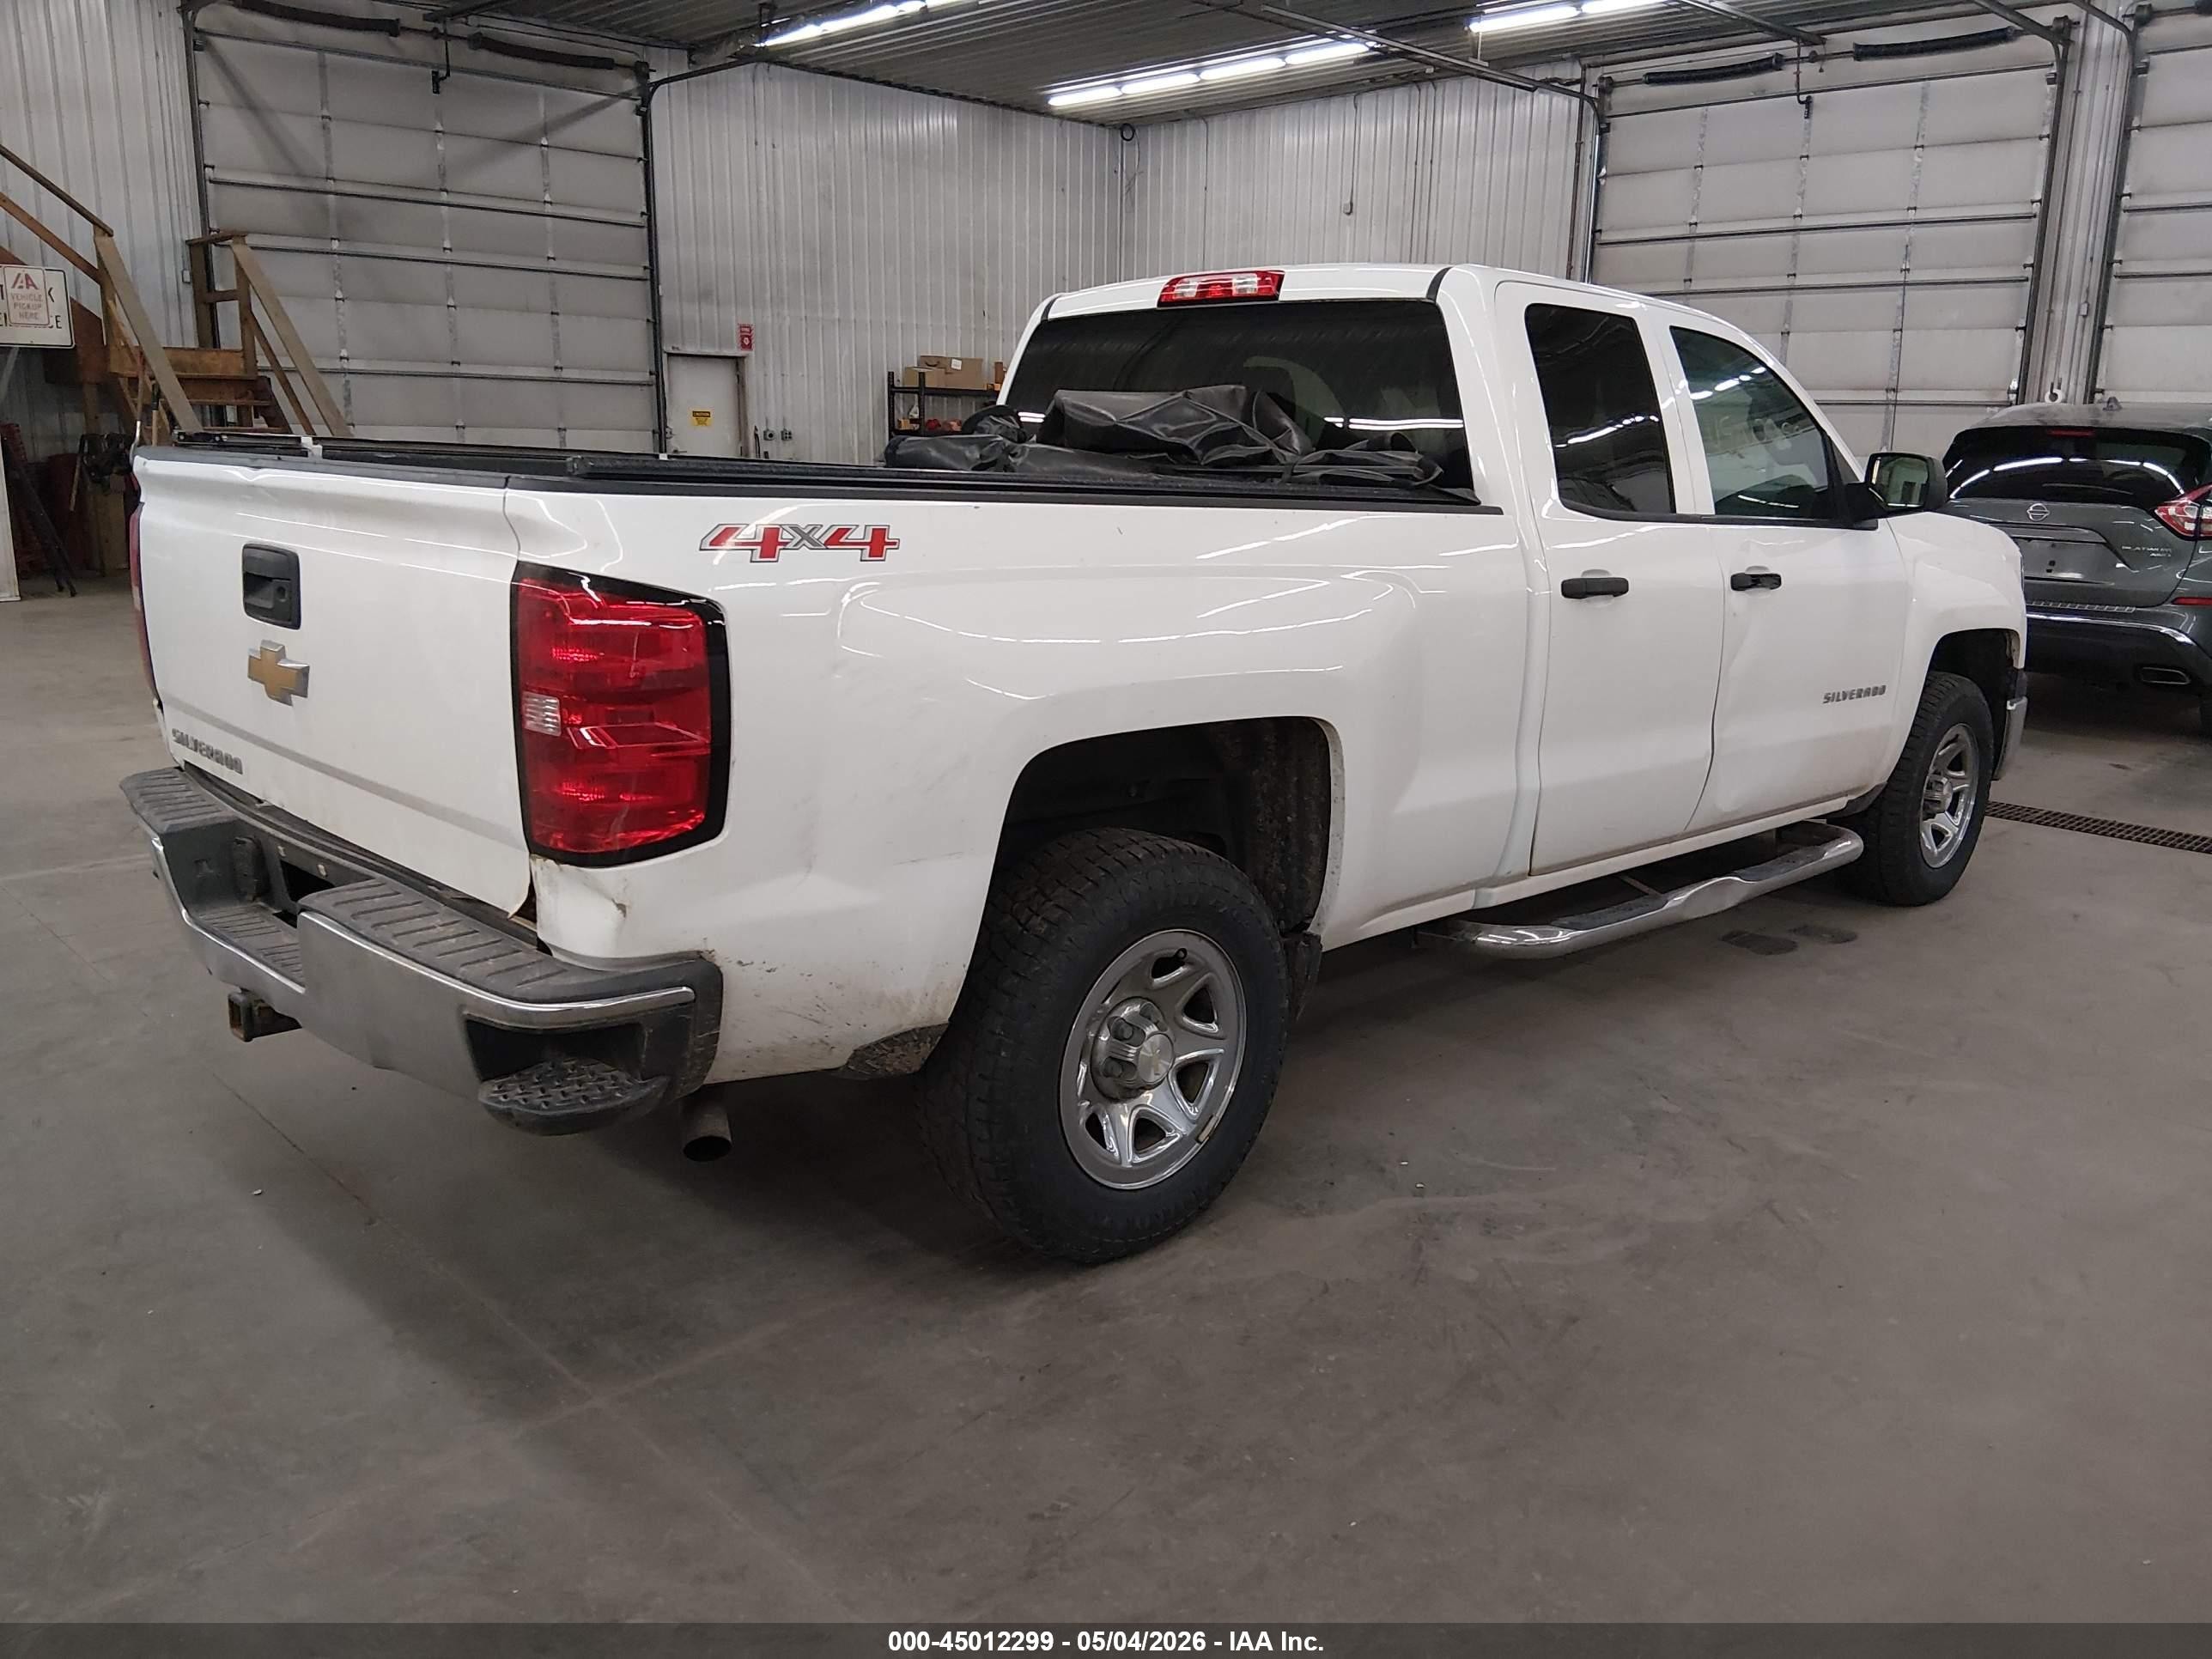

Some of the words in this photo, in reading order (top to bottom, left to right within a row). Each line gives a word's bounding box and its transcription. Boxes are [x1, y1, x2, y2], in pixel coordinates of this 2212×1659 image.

[11, 293, 43, 302] VEHICLE
[13, 301, 42, 310] PICKUP
[19, 312, 39, 320] HERE
[1822, 684, 1887, 704] SILVERADO
[172, 728, 243, 775] SILVERADO
